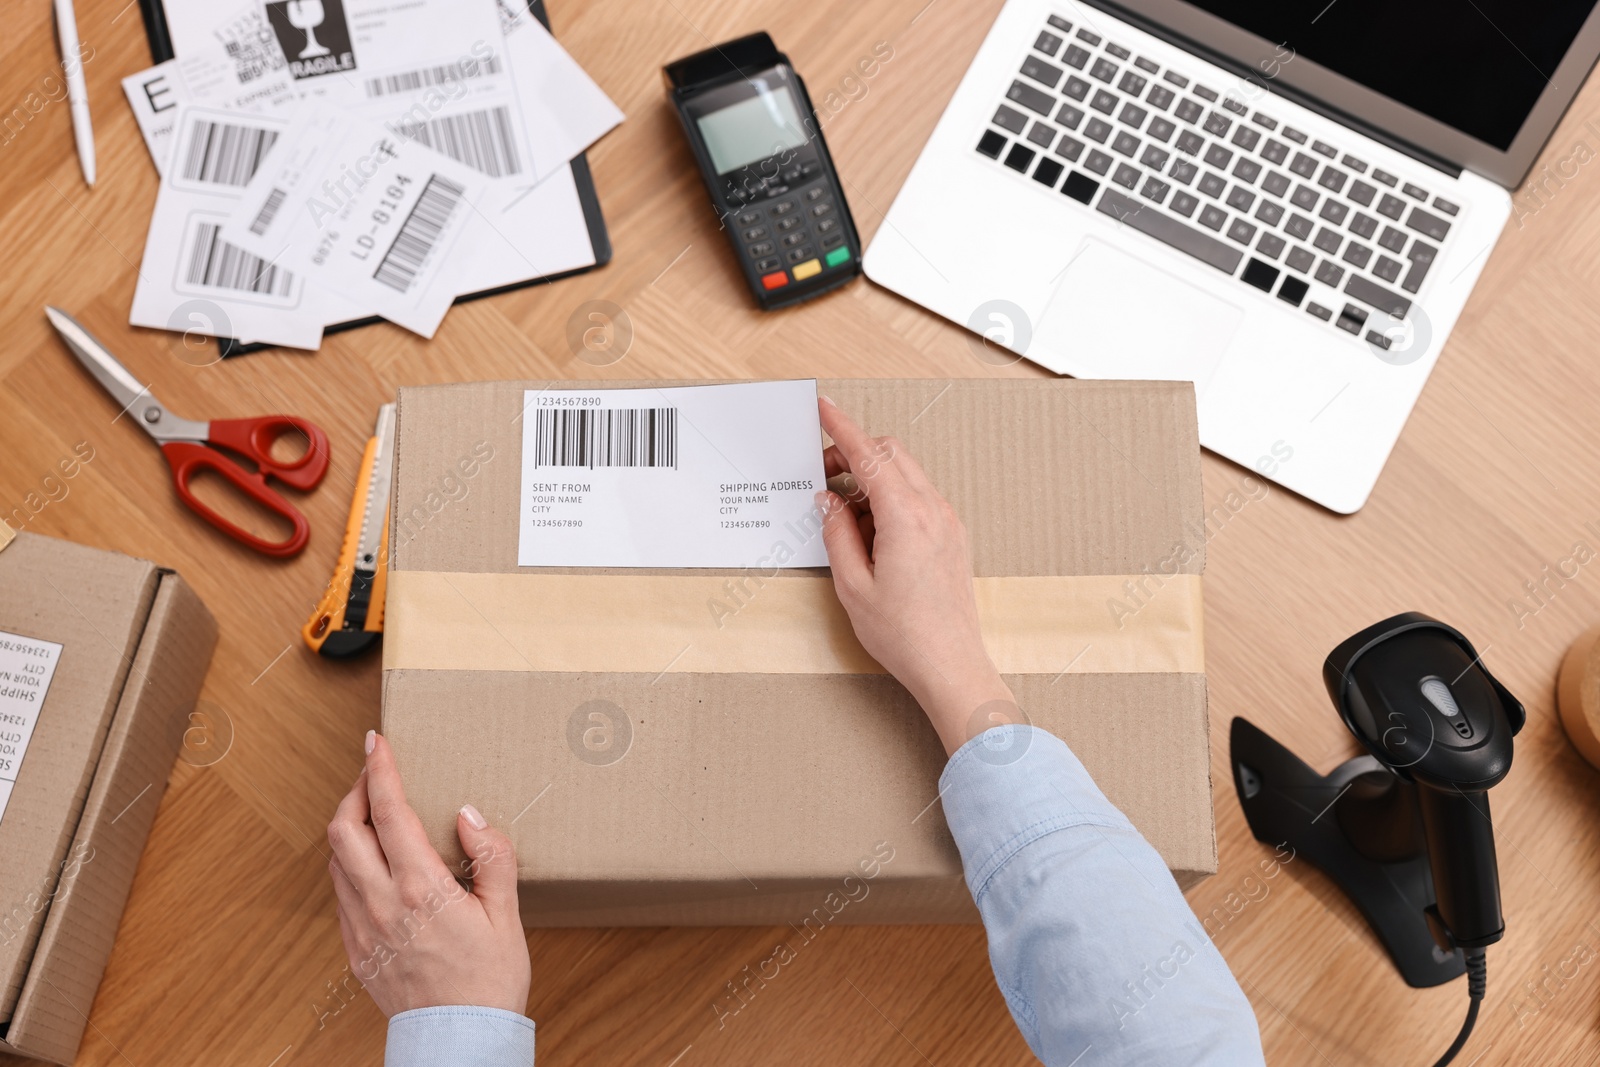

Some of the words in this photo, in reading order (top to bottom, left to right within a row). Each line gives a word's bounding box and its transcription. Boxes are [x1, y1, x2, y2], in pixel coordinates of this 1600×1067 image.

[290, 52, 354, 78] RAGILE
[536, 396, 602, 407] 1234567890
[532, 483, 558, 492] SENT
[561, 483, 592, 493] FROM
[719, 482, 767, 493] SHIPPING
[770, 480, 814, 491] ADDRESS
[532, 495, 556, 504] YOUR
[558, 496, 583, 504] NAME
[719, 496, 743, 504] YOUR
[745, 495, 769, 504] NAME
[531, 505, 551, 514] CITY
[719, 506, 739, 515] CITY
[532, 519, 583, 528] 1234567890
[719, 520, 771, 529] 1234567890
[22, 663, 46, 676] CITY
[13, 674, 41, 687] YOUR
[0, 685, 37, 702] SHIPP
